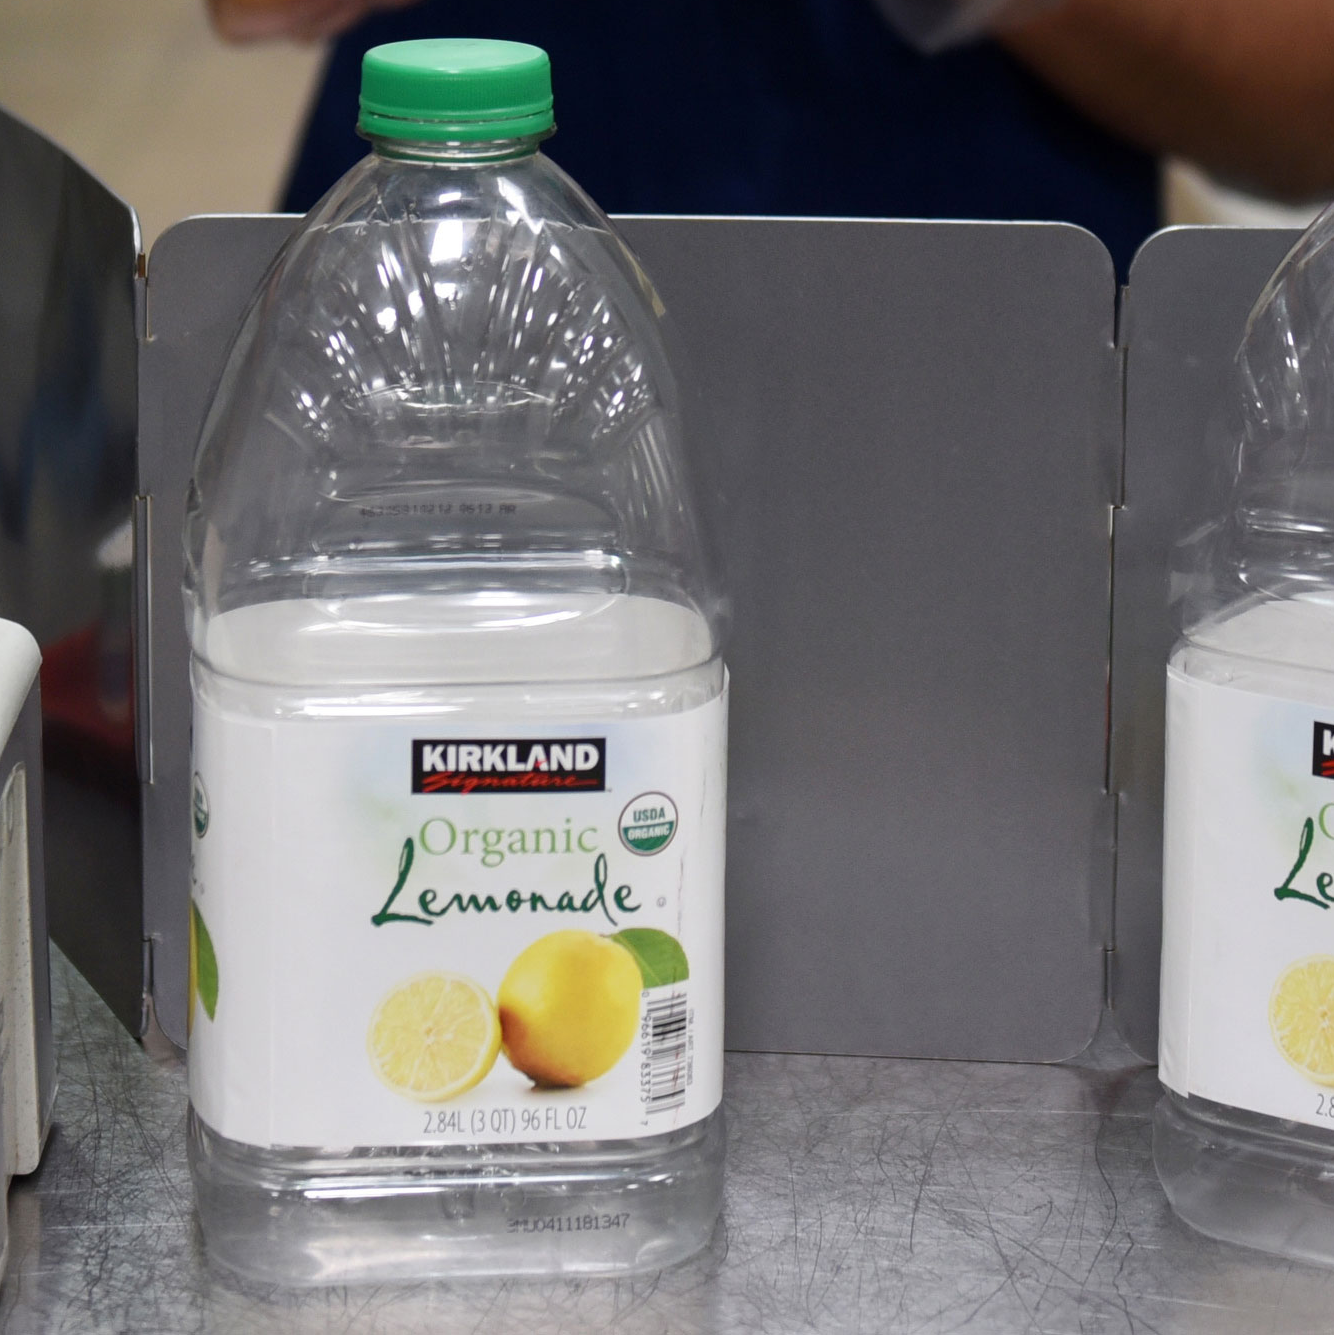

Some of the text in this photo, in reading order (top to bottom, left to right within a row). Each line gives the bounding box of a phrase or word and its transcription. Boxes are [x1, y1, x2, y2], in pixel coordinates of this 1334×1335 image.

[422, 743, 600, 772] KIRKLAND
[421, 771, 599, 795] Signature
[633, 807, 666, 823] USDA
[419, 817, 599, 868] Organic
[627, 824, 670, 842] ORGANIC
[371, 837, 642, 927] Lemonade
[641, 1015, 651, 1059] 96619
[640, 1063, 651, 1103] 83375
[423, 1106, 587, 1135] 2.84L (3 QT) 96 FL OZ
